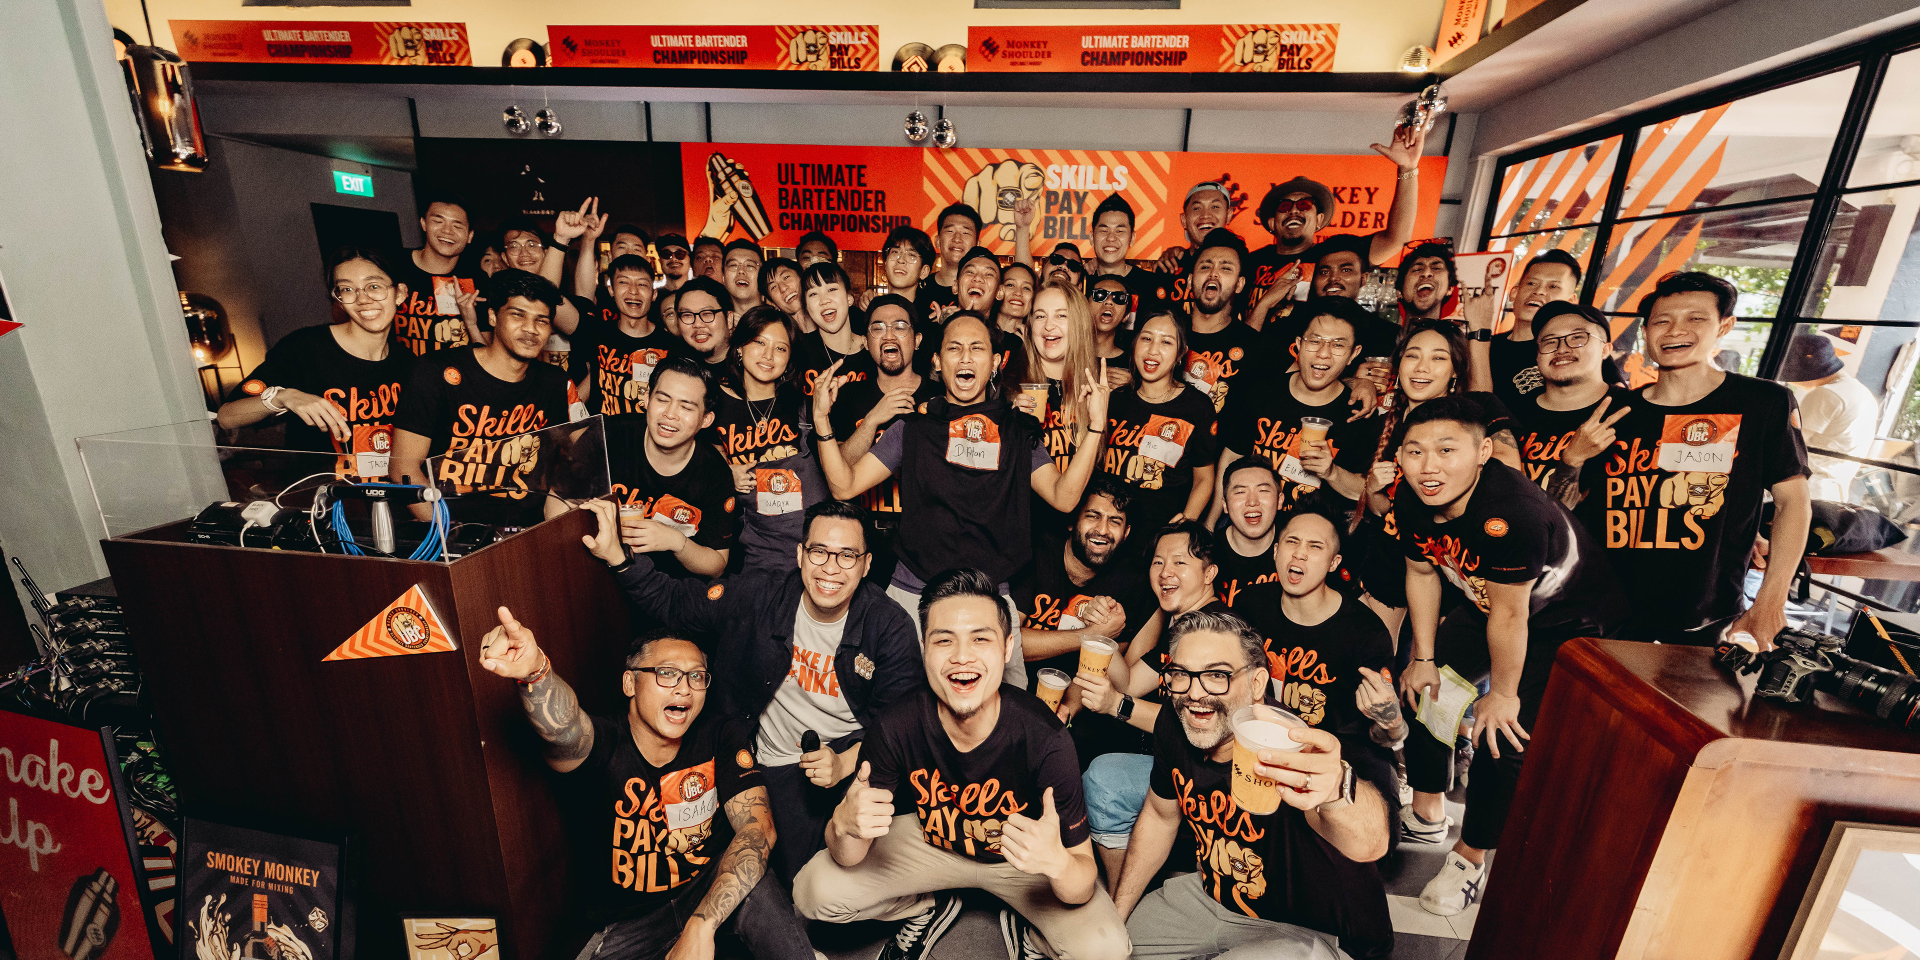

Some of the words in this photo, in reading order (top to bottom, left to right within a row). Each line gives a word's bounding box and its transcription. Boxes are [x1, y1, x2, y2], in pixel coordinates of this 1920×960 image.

[262, 30, 303, 41] ULTIMATE
[303, 30, 351, 42] BARTENDER
[422, 28, 459, 40] SKILLS
[650, 35, 694, 47] ULTIMATE
[694, 35, 748, 48] BARTENDER
[829, 31, 869, 45] SKILLS
[1081, 35, 1129, 48] ULTIMATE
[1130, 35, 1189, 48] BARTENDER
[1280, 30, 1326, 44] SKILLS
[267, 44, 353, 58] CHAMPIONSHIP
[425, 40, 443, 51] PAY
[829, 44, 850, 57] PAY
[1006, 40, 1048, 49] MONKEY
[1280, 44, 1303, 57] PAY
[427, 52, 455, 64] BILLS
[653, 50, 748, 65] CHAMPIONSHIP
[829, 57, 861, 69] BILLS
[1001, 50, 1052, 59] SHOULDER
[1081, 50, 1188, 66] CHAMPIONSHIP
[1277, 57, 1313, 70] BILLS
[342, 175, 365, 193] EXIT
[777, 163, 867, 187] ULTIMATE
[1045, 164, 1128, 191] SKILLS
[778, 188, 886, 212] BARTENDER
[1045, 191, 1089, 215] PAY
[779, 212, 911, 233] CHAMPIONSHIP
[1043, 215, 1090, 240] BILL
[395, 314, 432, 340] PAY
[323, 382, 401, 421] Skill
[452, 403, 548, 437] Skills
[967, 429, 983, 438] UBC
[1254, 417, 1297, 450] Ski
[1686, 431, 1709, 442] UBC
[374, 440, 390, 450] UBC
[445, 436, 501, 464] PAY
[1520, 431, 1576, 461] kil
[1104, 447, 1130, 476] AY
[1605, 437, 1661, 476] Ski
[1673, 450, 1724, 464] JASON
[1606, 474, 1659, 509] PAY
[673, 511, 691, 523] UBC
[1606, 508, 1706, 551] BILLS
[398, 624, 426, 645] UBC
[792, 645, 822, 670] AKE
[1079, 661, 1101, 673] ONKEY
[788, 664, 840, 698] NKE
[0, 738, 110, 805] ake
[1244, 774, 1277, 788] SHO
[684, 783, 703, 799] UBC
[909, 768, 1029, 817] Skills
[1172, 768, 1265, 843] Skills
[612, 816, 668, 854] PAY
[206, 851, 260, 876] SMOKEY
[264, 861, 320, 888] MONKEY
[229, 875, 249, 886] MADE
[251, 879, 266, 889] FOR
[267, 882, 294, 895] MIXING
